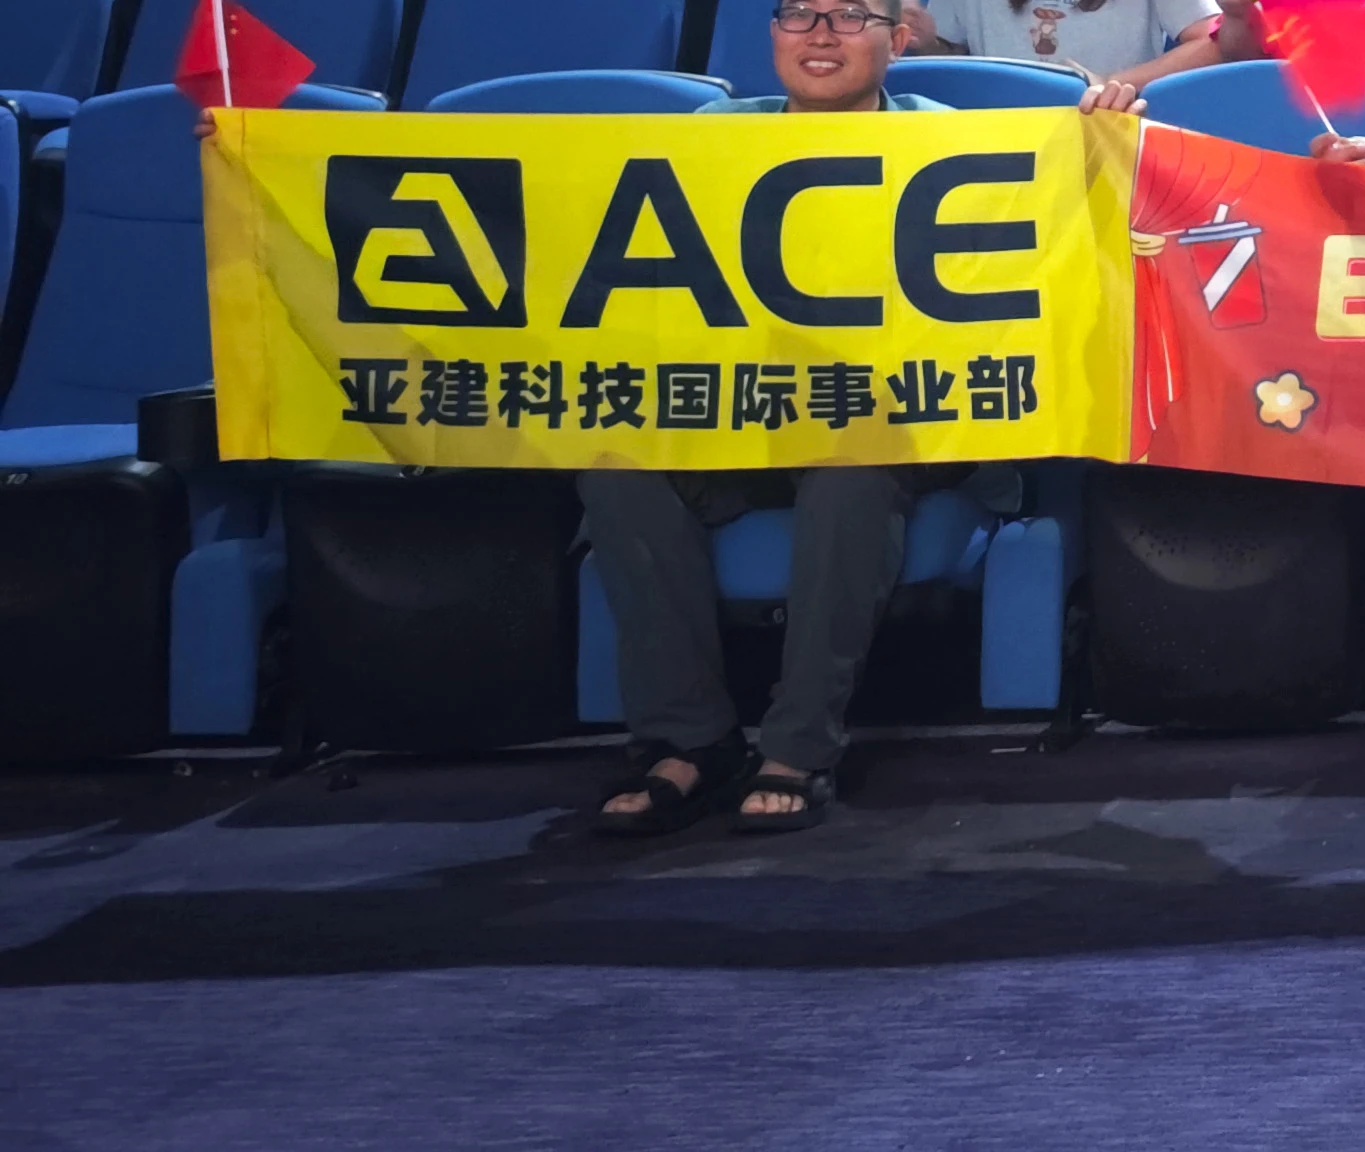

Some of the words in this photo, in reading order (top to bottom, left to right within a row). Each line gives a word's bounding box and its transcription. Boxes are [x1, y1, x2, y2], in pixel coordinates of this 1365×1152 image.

[560, 152, 1041, 328] ACE
[338, 355, 1038, 431] 亚建科技国际事业部
